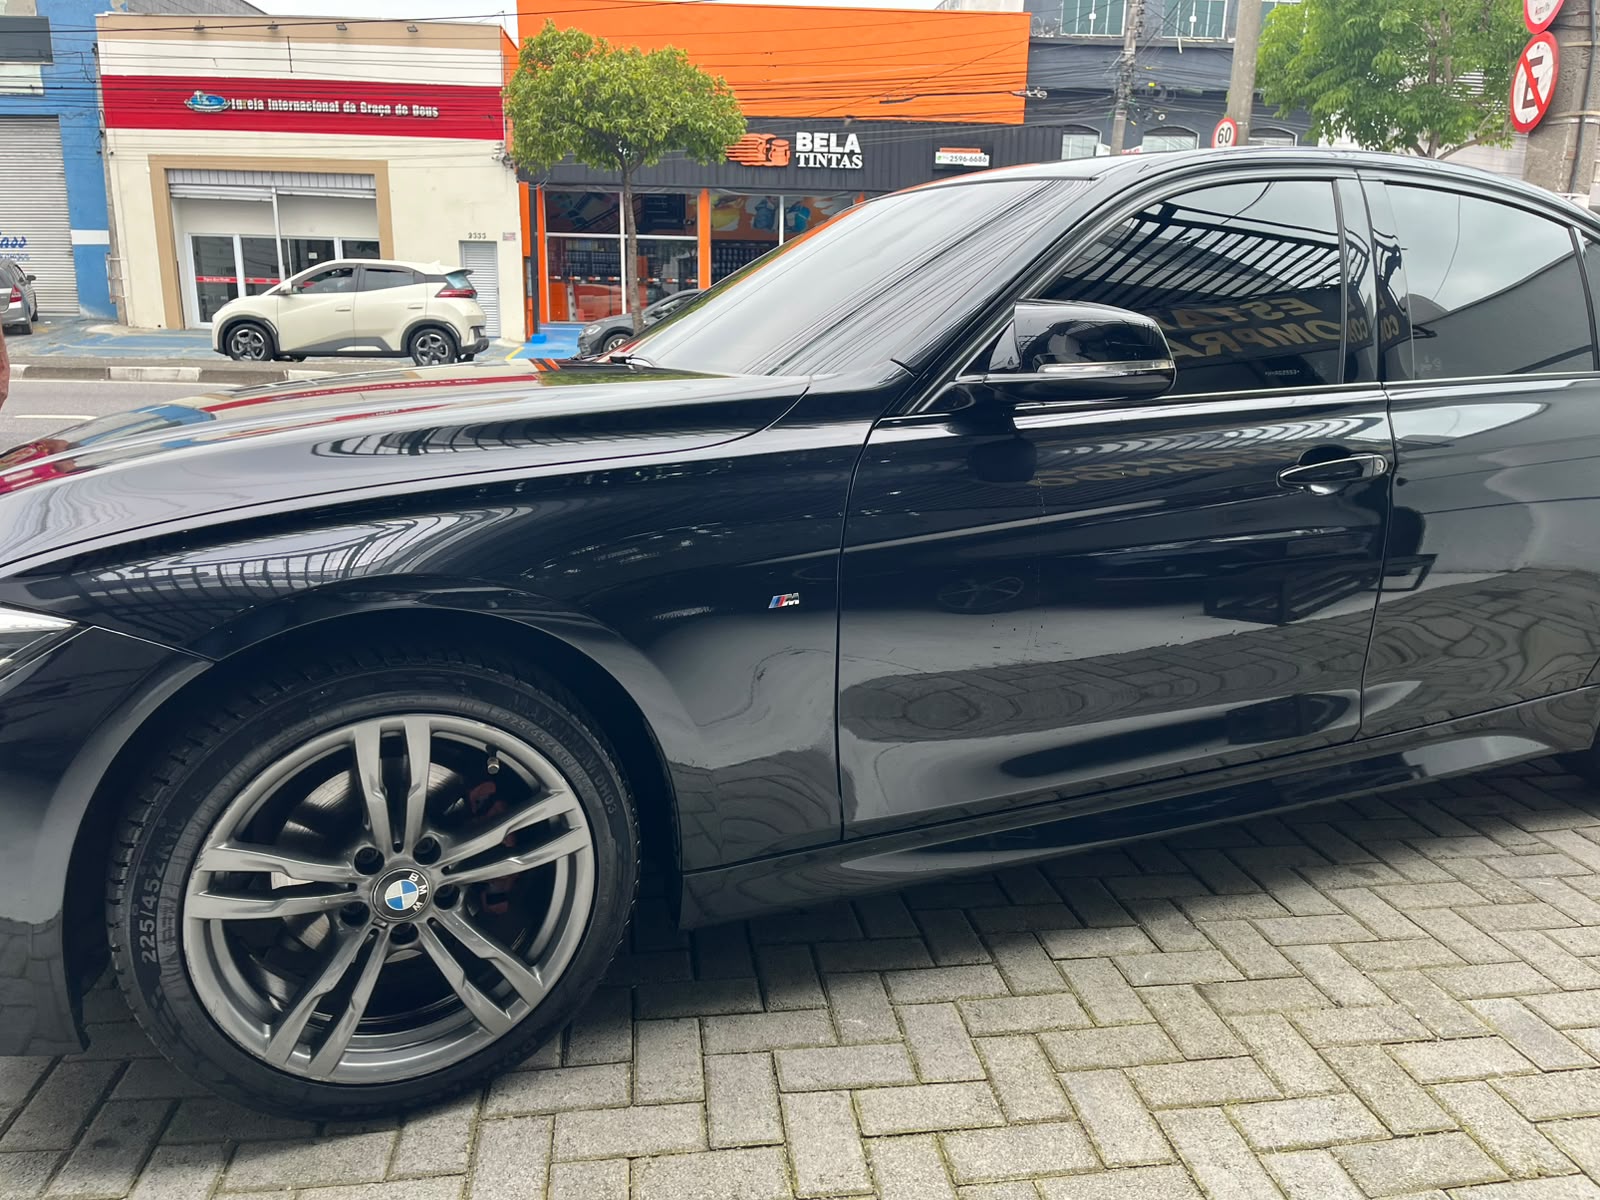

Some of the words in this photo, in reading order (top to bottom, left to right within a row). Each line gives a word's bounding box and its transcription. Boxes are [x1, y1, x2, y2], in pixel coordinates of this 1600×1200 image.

[1522, 55, 1544, 109] E
[796, 131, 861, 153] BELA
[1217, 127, 1232, 144] 60
[796, 152, 863, 169] TINTAS
[408, 871, 428, 912] BMW
